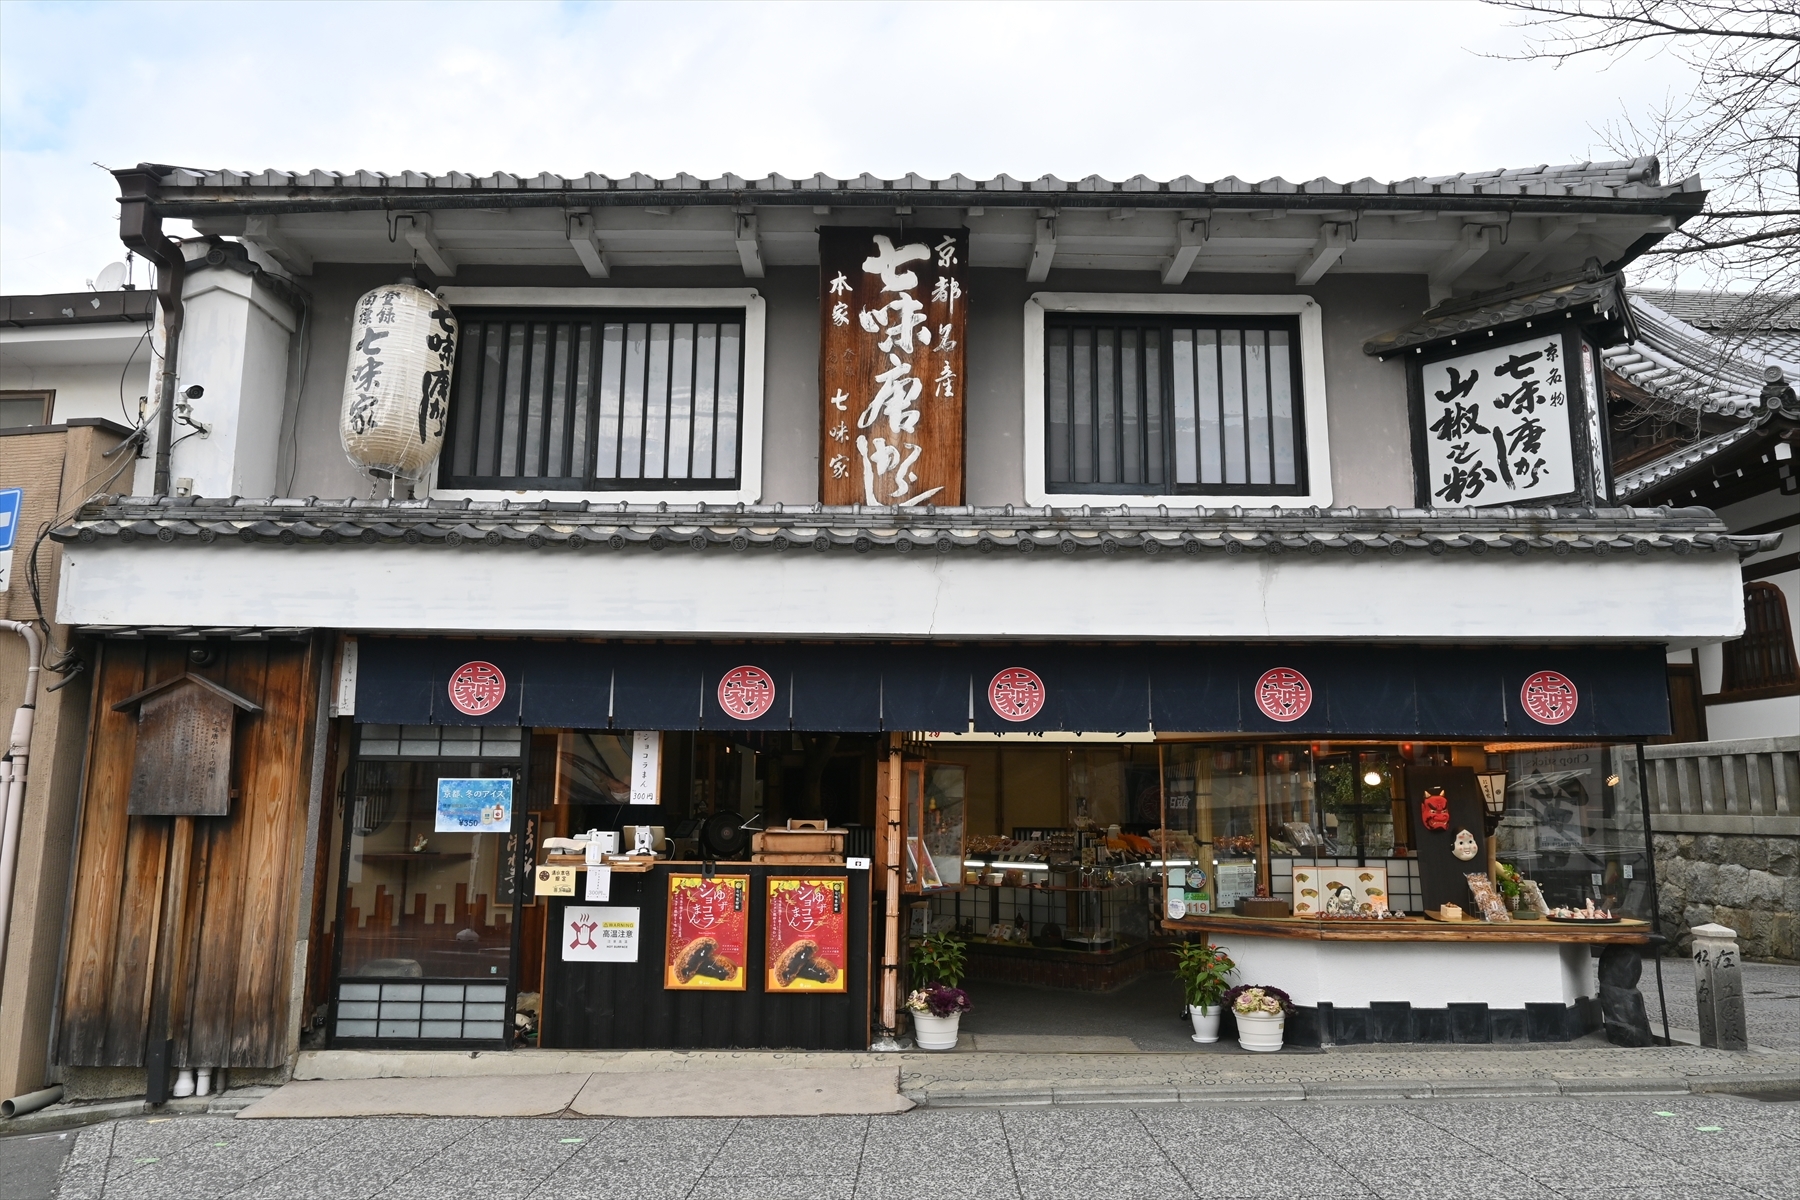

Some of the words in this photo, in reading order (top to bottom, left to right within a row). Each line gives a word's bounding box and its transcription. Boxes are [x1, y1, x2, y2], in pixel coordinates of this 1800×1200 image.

[829, 271, 853, 327] 本家
[932, 235, 962, 397] 京都名産
[350, 327, 390, 435] 七味家
[1544, 342, 1565, 407] 京名物
[829, 388, 851, 478] 七味家
[640, 733, 650, 788] ショコラまん
[442, 789, 506, 799] 京都、冬のアイス
[633, 792, 654, 801] 300円
[459, 819, 480, 827] ¥350
[699, 883, 715, 929] ショコラ
[713, 889, 728, 912] ゆず
[797, 886, 814, 931] ショコラ
[812, 892, 827, 914] ゆず
[1186, 902, 1208, 912] 119
[689, 904, 702, 924] まん
[789, 906, 801, 927] まん
[602, 929, 633, 939] 高温注意
